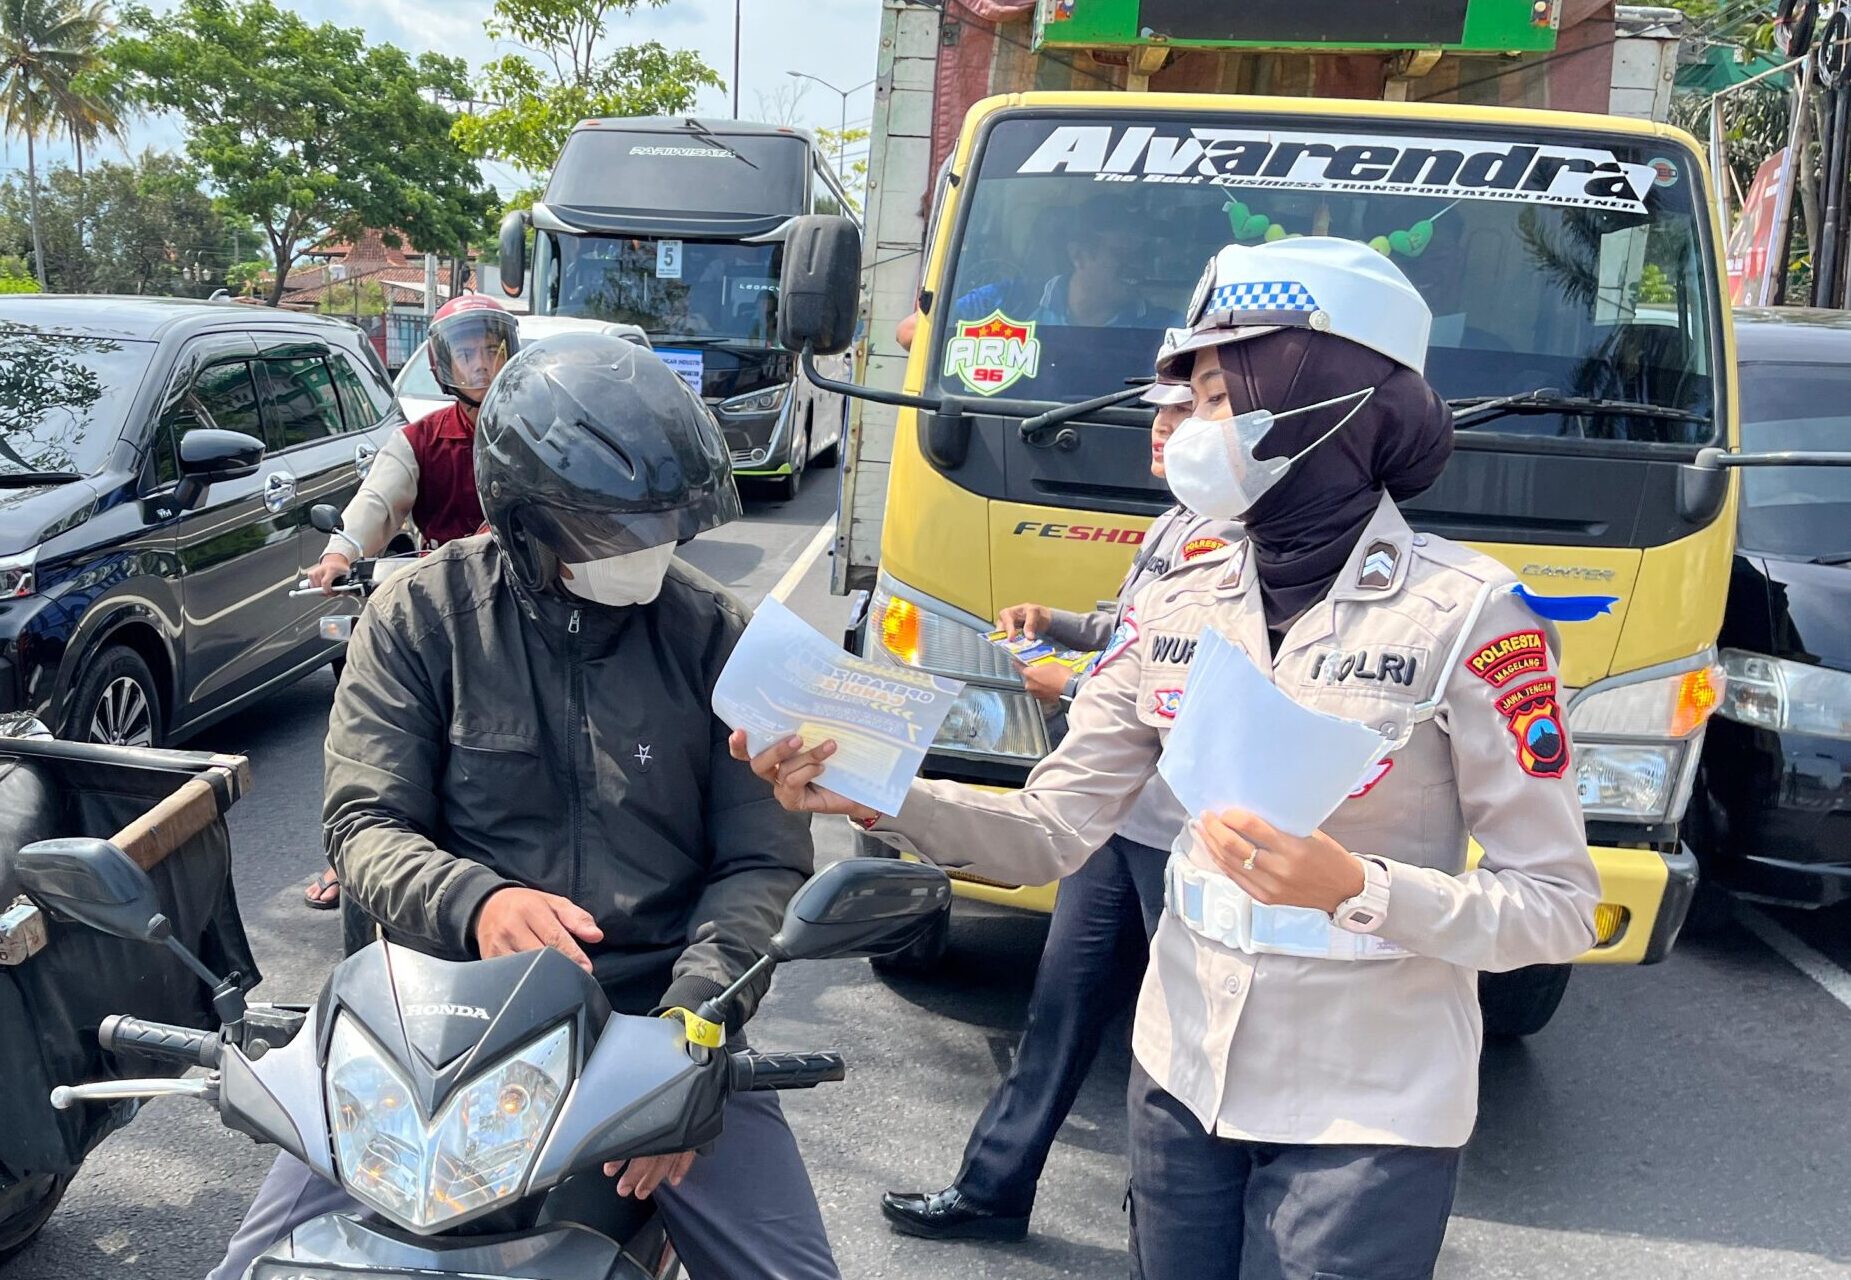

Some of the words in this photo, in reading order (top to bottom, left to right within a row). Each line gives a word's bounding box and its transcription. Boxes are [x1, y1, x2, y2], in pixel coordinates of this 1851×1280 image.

[1017, 126, 1645, 203] Alvarendra
[1093, 173, 1137, 182] The
[1143, 174, 1203, 184] Best
[1330, 183, 1532, 199] TRANSPORTATION
[1536, 194, 1636, 209] PARTNER
[663, 247, 674, 267] 5
[945, 338, 1039, 377] ARM
[974, 368, 1004, 382] 96
[1184, 539, 1228, 553] POLREST
[1472, 634, 1542, 671] POLRESTA
[1494, 658, 1540, 682] MAGELANG
[1503, 691, 1524, 710] JAWA
[405, 1003, 490, 1020] HONDA
